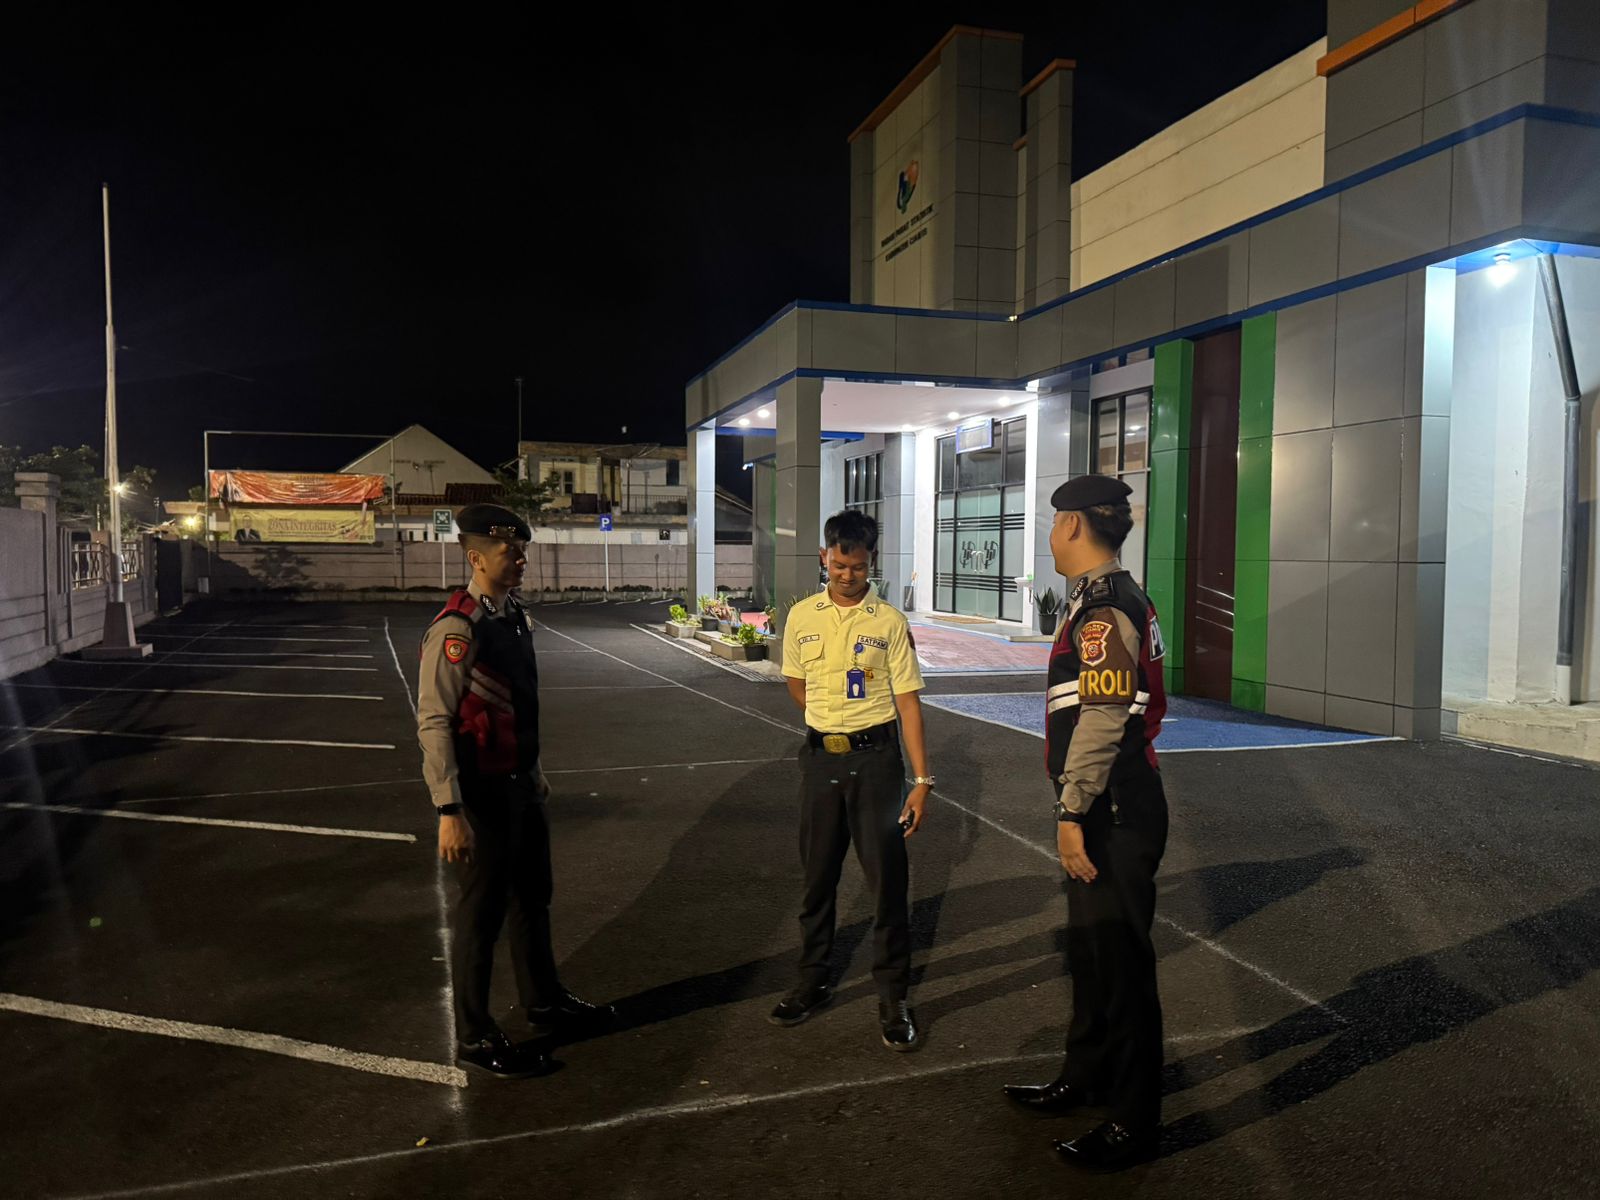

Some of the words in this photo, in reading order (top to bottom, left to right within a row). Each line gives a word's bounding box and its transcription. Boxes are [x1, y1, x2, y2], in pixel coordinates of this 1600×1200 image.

[601, 517, 610, 528] P
[860, 637, 888, 649] SATPAM
[1078, 669, 1131, 697] TROLI
